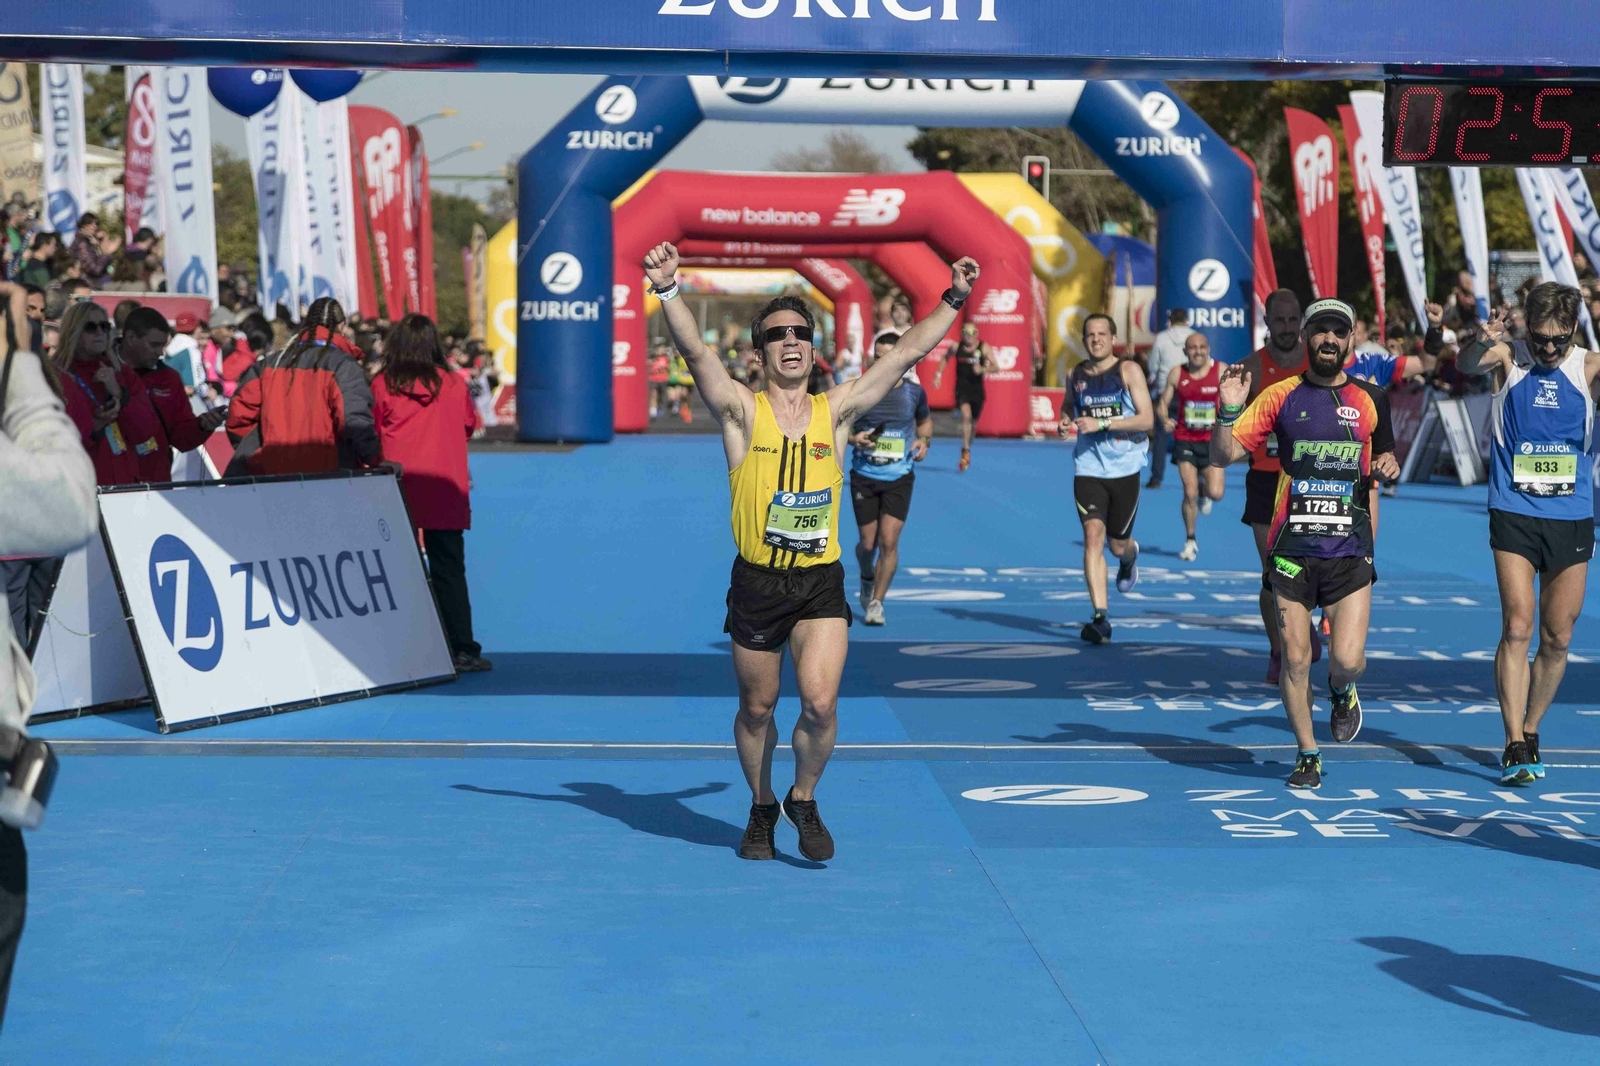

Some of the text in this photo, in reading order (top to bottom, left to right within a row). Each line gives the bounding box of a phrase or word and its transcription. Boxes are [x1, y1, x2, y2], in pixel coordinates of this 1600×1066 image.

[566, 130, 653, 150] ZURICH
[1115, 136, 1201, 156] ZURICH
[702, 207, 821, 226] new balance
[521, 300, 599, 320] ZURICH
[1168, 308, 1245, 327] URICH
[1535, 461, 1558, 473] 833
[1310, 483, 1346, 492] ZURICH
[798, 493, 828, 505] ZURICH
[1305, 500, 1338, 513] 1726
[794, 515, 818, 528] 756
[230, 549, 398, 630] ZURICH
